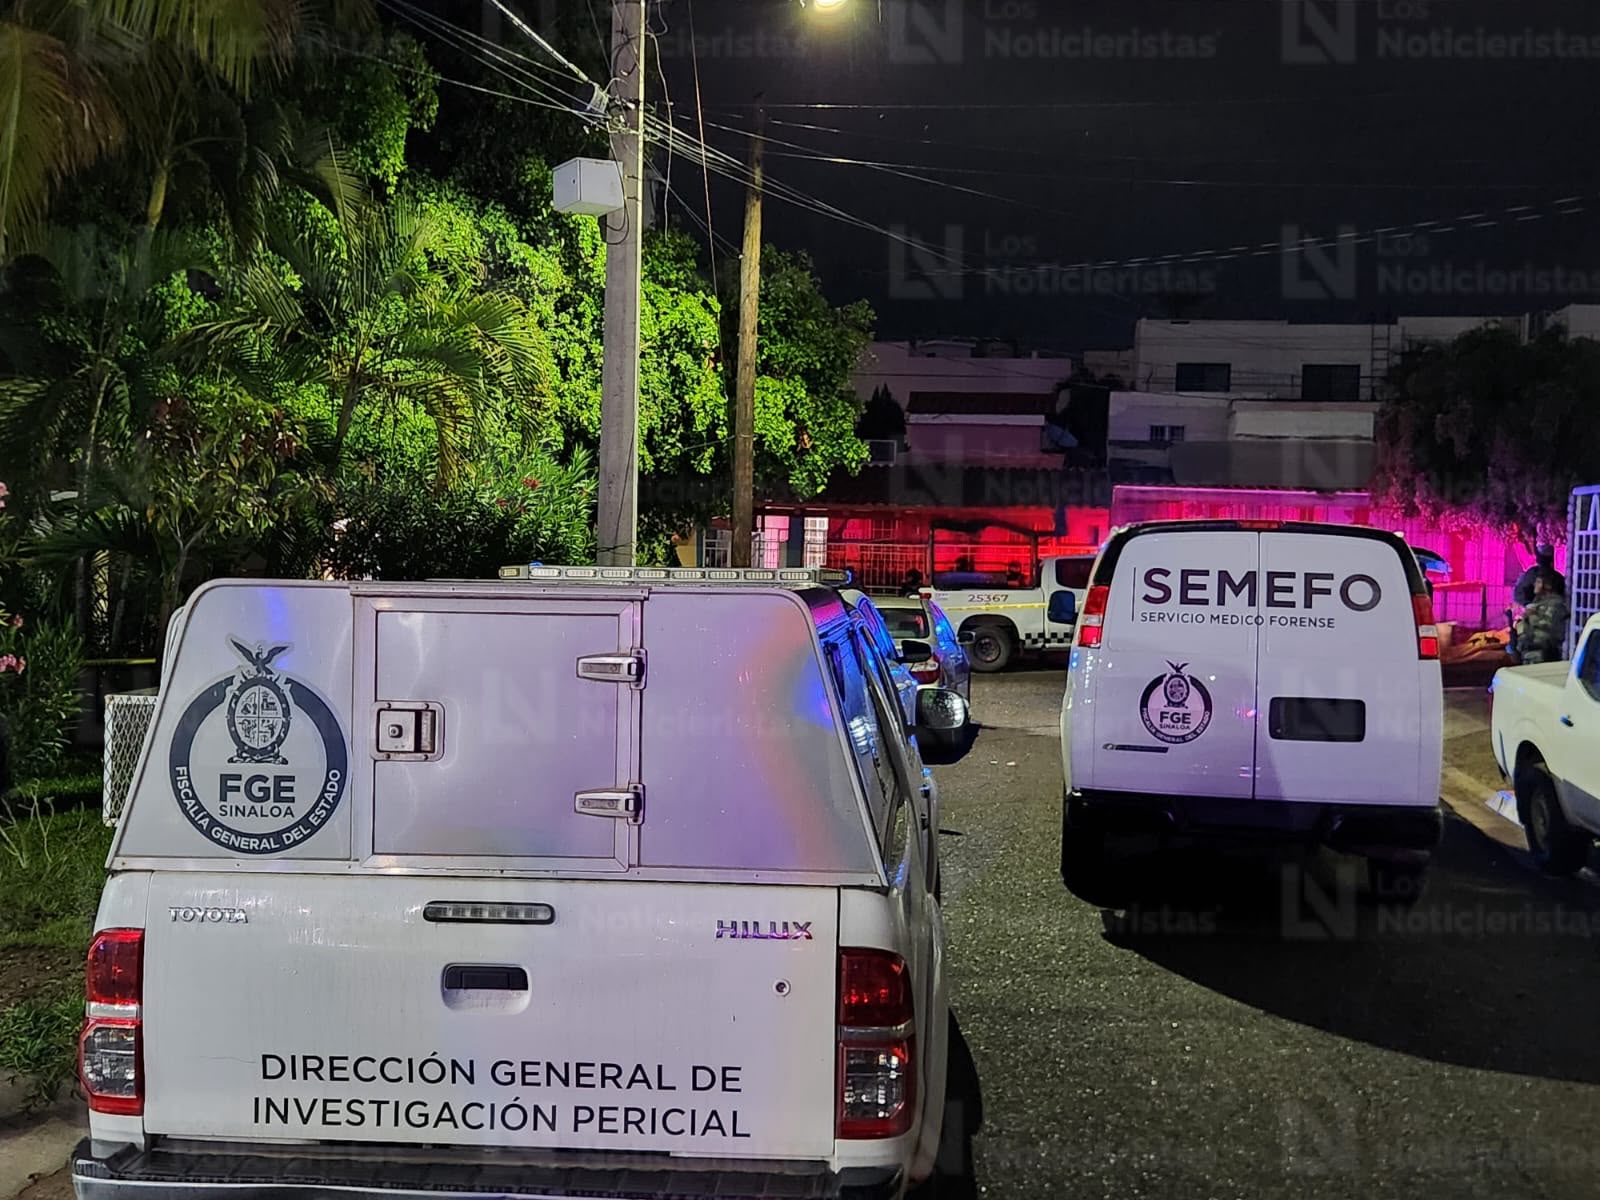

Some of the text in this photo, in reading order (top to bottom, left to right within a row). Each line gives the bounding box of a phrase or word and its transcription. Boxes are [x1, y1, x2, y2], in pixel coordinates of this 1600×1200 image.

[968, 594, 1008, 603] 25367
[1142, 568, 1382, 612] SEMEFO
[1140, 612, 1335, 629] SERVICIO MEDICO FORENSE
[1159, 723, 1190, 731] SINALOA
[1160, 711, 1191, 724] FGE
[219, 773, 295, 804] FGE
[175, 766, 341, 850] FISCALÍA GENERAL DEL ESTADO
[219, 804, 295, 818] SINALOA
[168, 906, 249, 924] TOYOTA
[716, 920, 813, 940] HILUX
[262, 1051, 742, 1093] DIRECCIÓN GENERAL DE
[254, 1096, 751, 1138] INVESTIGACIÓN PERICIAL
